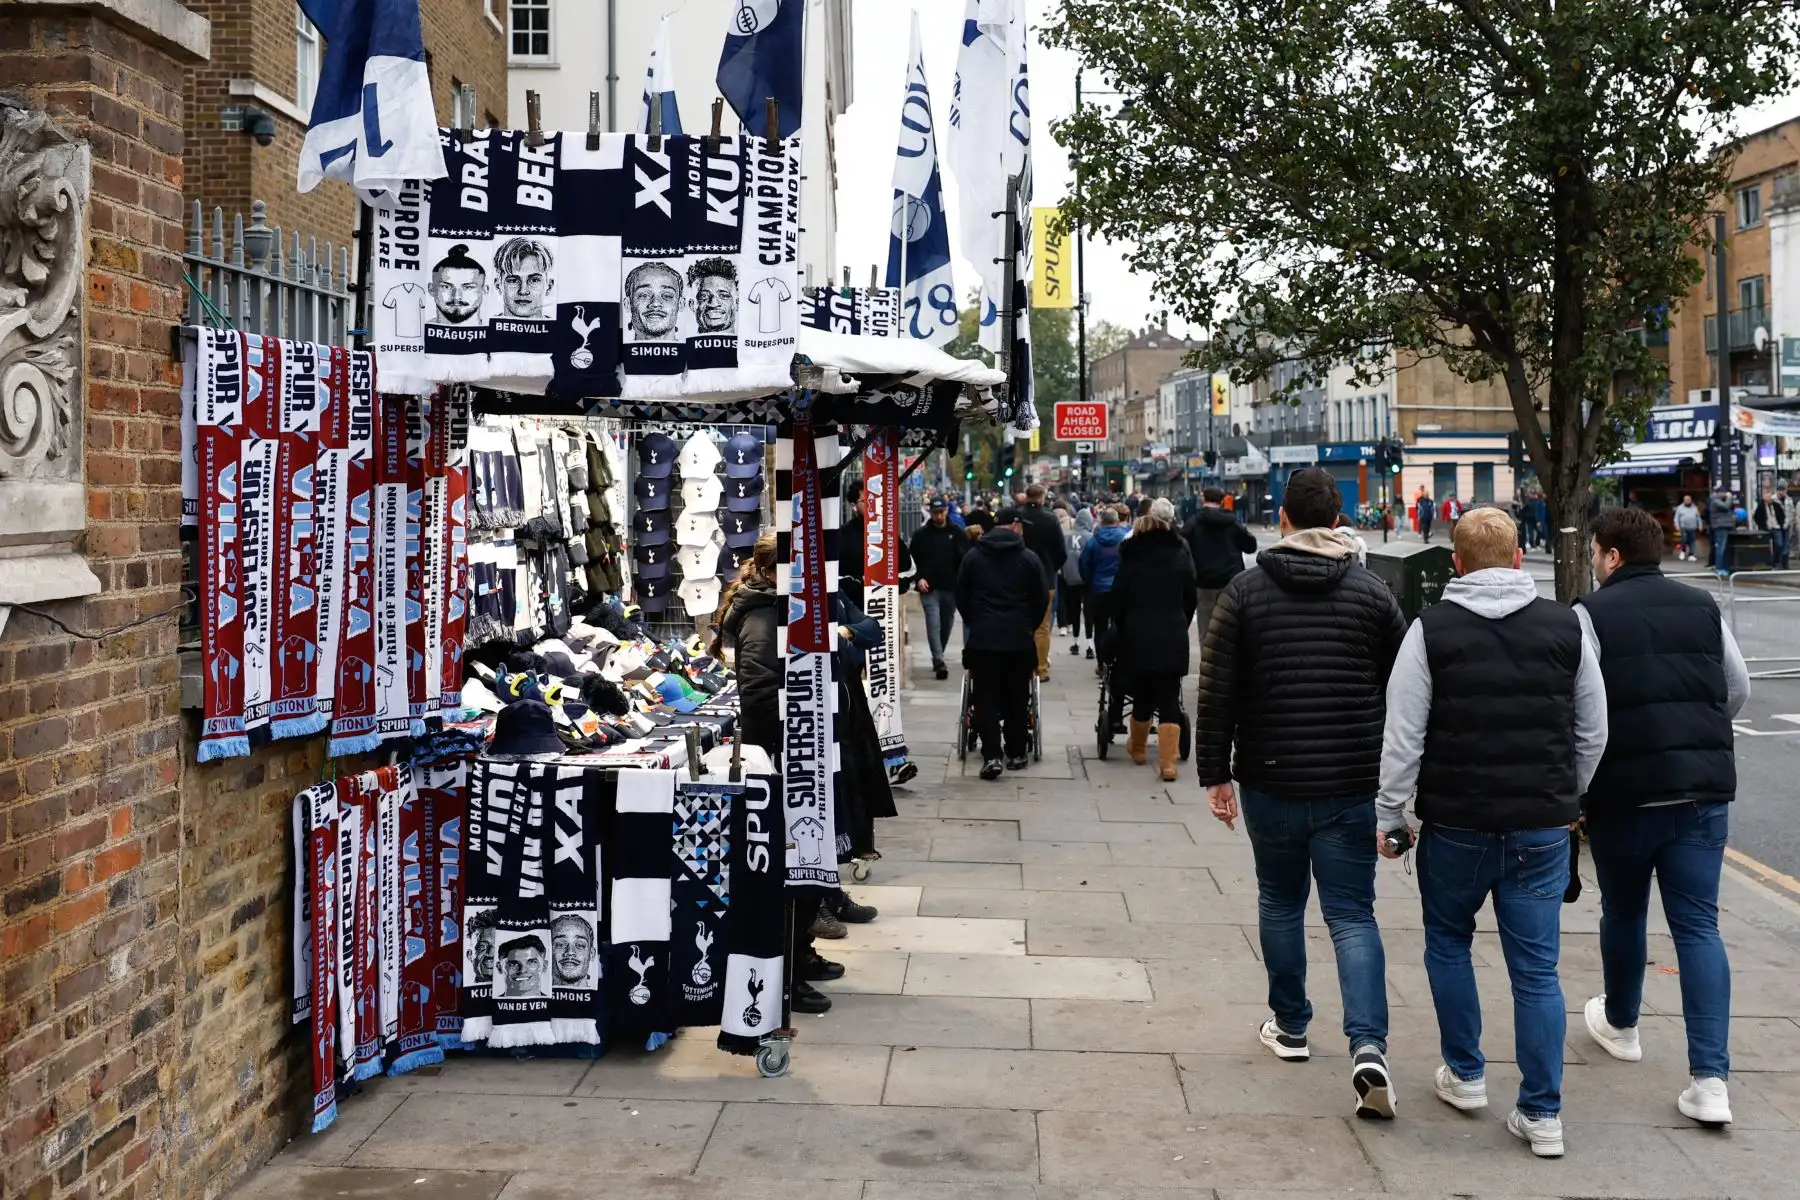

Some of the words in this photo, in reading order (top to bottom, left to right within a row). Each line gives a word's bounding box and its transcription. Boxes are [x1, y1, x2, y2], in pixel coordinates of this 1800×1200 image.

[787, 156, 799, 224] KNOW
[379, 225, 390, 270] ARE
[785, 231, 796, 262] WE
[495, 321, 549, 334] BERGVALL
[744, 337, 795, 348] SUPERSPUR
[872, 311, 889, 338] EUR
[380, 344, 424, 353] SUPERSP
[631, 346, 678, 358] SIMONS
[694, 338, 738, 350] KUDUS
[266, 377, 274, 429] PRIDE
[332, 389, 341, 439] PRIDE
[1067, 407, 1096, 416] ROAD
[1060, 426, 1103, 436] CLOSED
[1063, 417, 1099, 426] AHEAD
[206, 436, 215, 492] PRIDE
[281, 442, 290, 492] PRIDE
[387, 427, 397, 474] PRIDE
[262, 443, 272, 507] LONDON
[327, 452, 338, 514] LONDON
[207, 498, 215, 519] OF
[280, 496, 289, 517] OF
[385, 486, 397, 542] LONDON
[260, 511, 270, 567] NORTH
[324, 514, 335, 570] NORTH
[887, 534, 893, 547] OF
[207, 525, 216, 655] BIRMINGHAM
[260, 572, 269, 591] OF
[277, 522, 288, 642] BIRMINGHAM
[322, 574, 332, 594] OF
[386, 548, 396, 597] NORTH
[812, 578, 821, 596] OF
[259, 598, 268, 644] PRIDE
[319, 597, 330, 642] PRIDE
[387, 601, 396, 619] OF
[813, 600, 823, 644] PRIDE
[387, 621, 398, 665] PRIDE
[814, 654, 823, 709] LONDON
[888, 661, 895, 673] OF
[382, 719, 409, 731] SPUR
[786, 669, 817, 809] SUPERSPUR
[816, 711, 825, 758] NORTH
[817, 761, 826, 778] OF
[509, 782, 528, 834] MICKY
[818, 779, 827, 821] PRIDE
[425, 797, 433, 840] PRIDE
[316, 837, 324, 885] PRIDE
[425, 843, 433, 860] OF
[789, 868, 815, 881] SUPER
[317, 891, 324, 911] OF
[497, 1001, 514, 1011] VAN
[516, 1001, 527, 1011] DE
[529, 1001, 547, 1011] VEN
[552, 991, 591, 1002] SIMONS
[682, 981, 718, 995] TOTTENHAM
